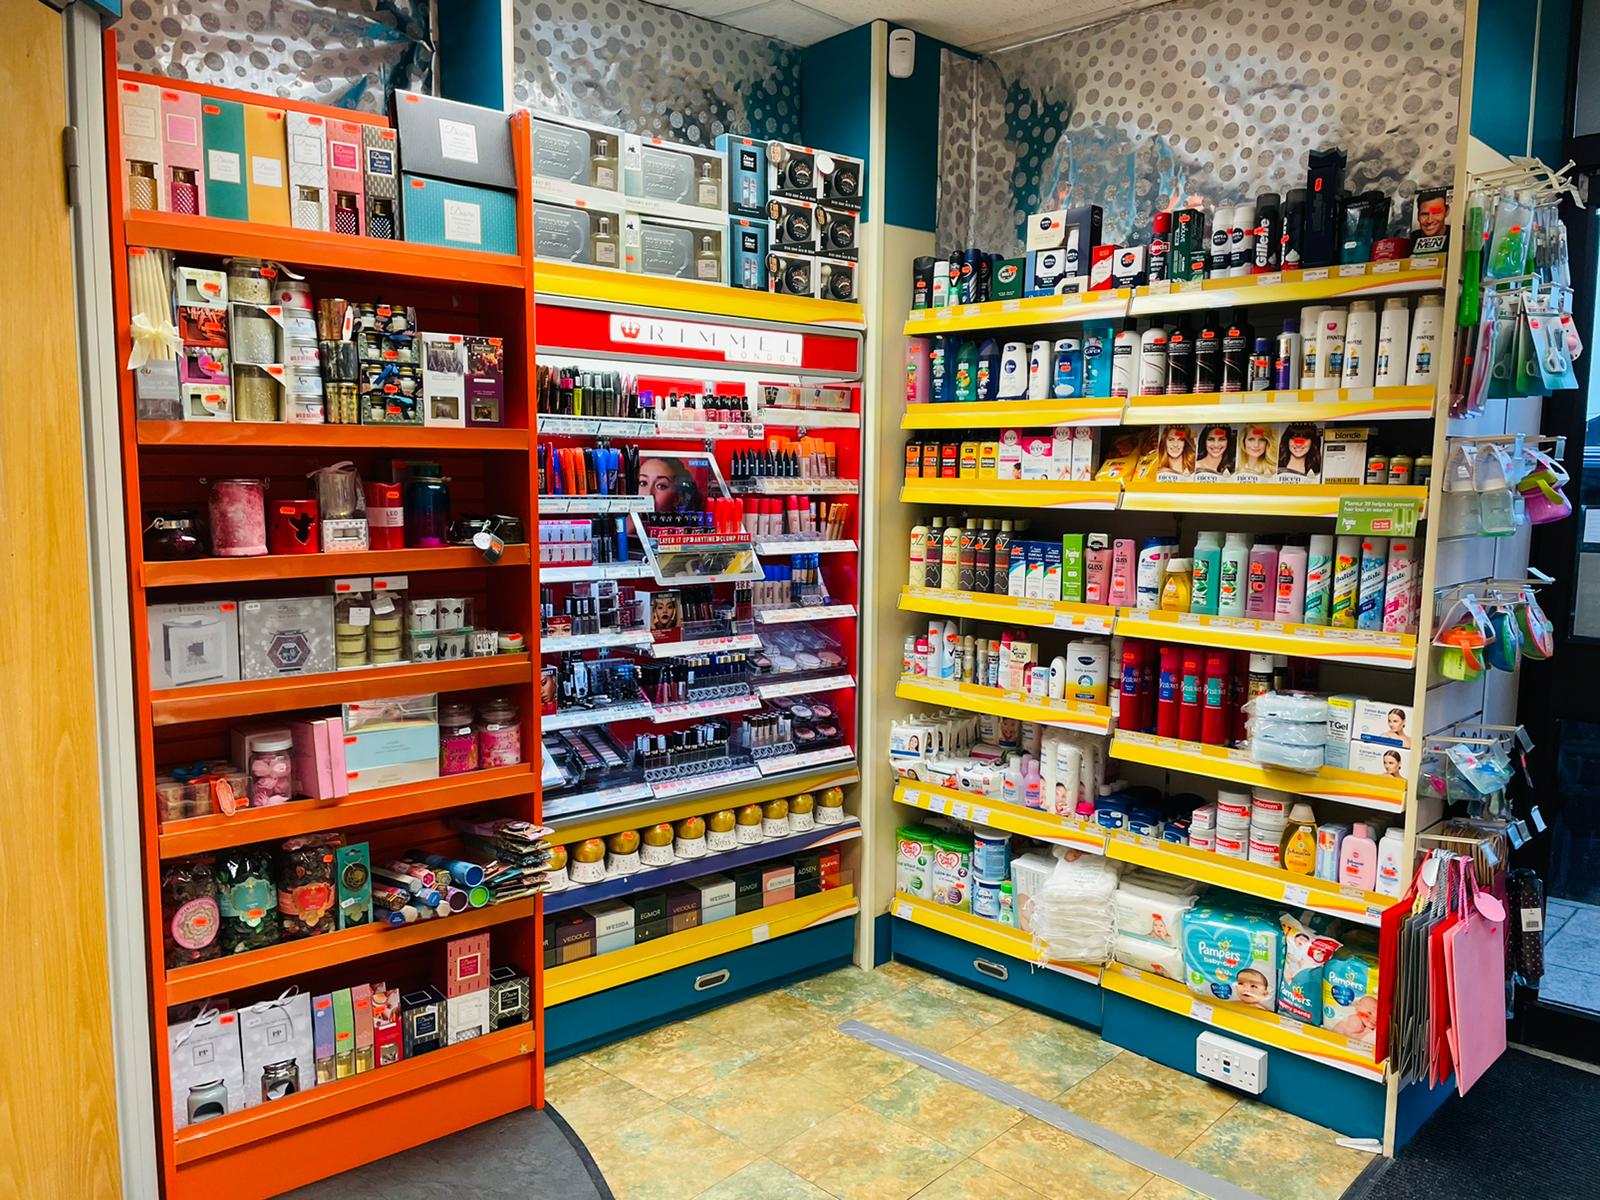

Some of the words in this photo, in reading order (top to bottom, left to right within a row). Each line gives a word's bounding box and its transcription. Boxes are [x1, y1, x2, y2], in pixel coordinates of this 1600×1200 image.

[649, 323, 792, 354] RIMMEL
[728, 350, 799, 363] LONDON
[1335, 431, 1361, 439] blonde
[1087, 563, 1102, 571] GLISS
[920, 857, 925, 865] 1
[960, 869, 966, 877] 2
[1198, 941, 1241, 961] Pampers
[1328, 971, 1364, 992] Pampers
